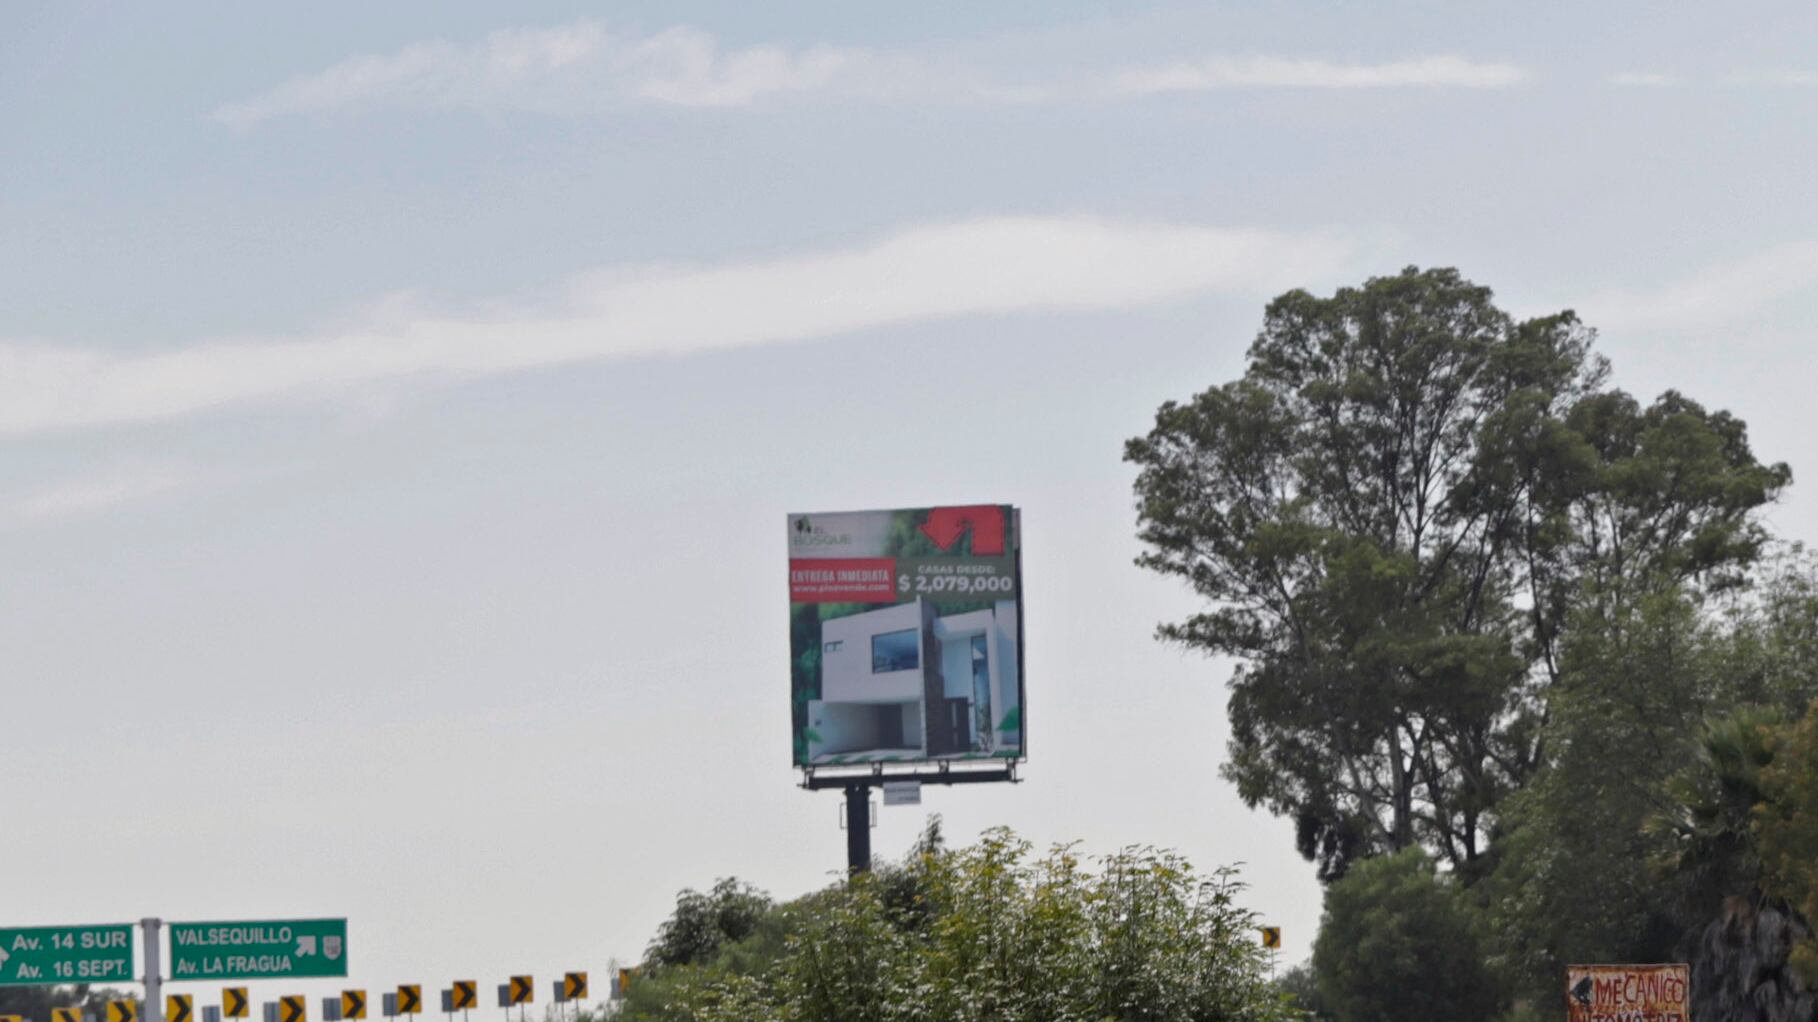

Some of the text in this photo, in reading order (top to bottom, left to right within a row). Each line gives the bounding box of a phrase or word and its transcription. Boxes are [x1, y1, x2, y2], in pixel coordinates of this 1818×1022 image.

[792, 569, 889, 582] ENTREGA INMEDIATA
[918, 565, 953, 574] CASAS
[899, 574, 1013, 594] $ 2,079,000
[12, 931, 127, 950] Av. 14 SUR
[176, 926, 292, 945] VALSEQUILLO
[17, 959, 128, 979] Av. 16 SEPT.
[176, 955, 292, 973] Av. LA FRAGUA
[1596, 973, 1685, 1006] MECANICO
